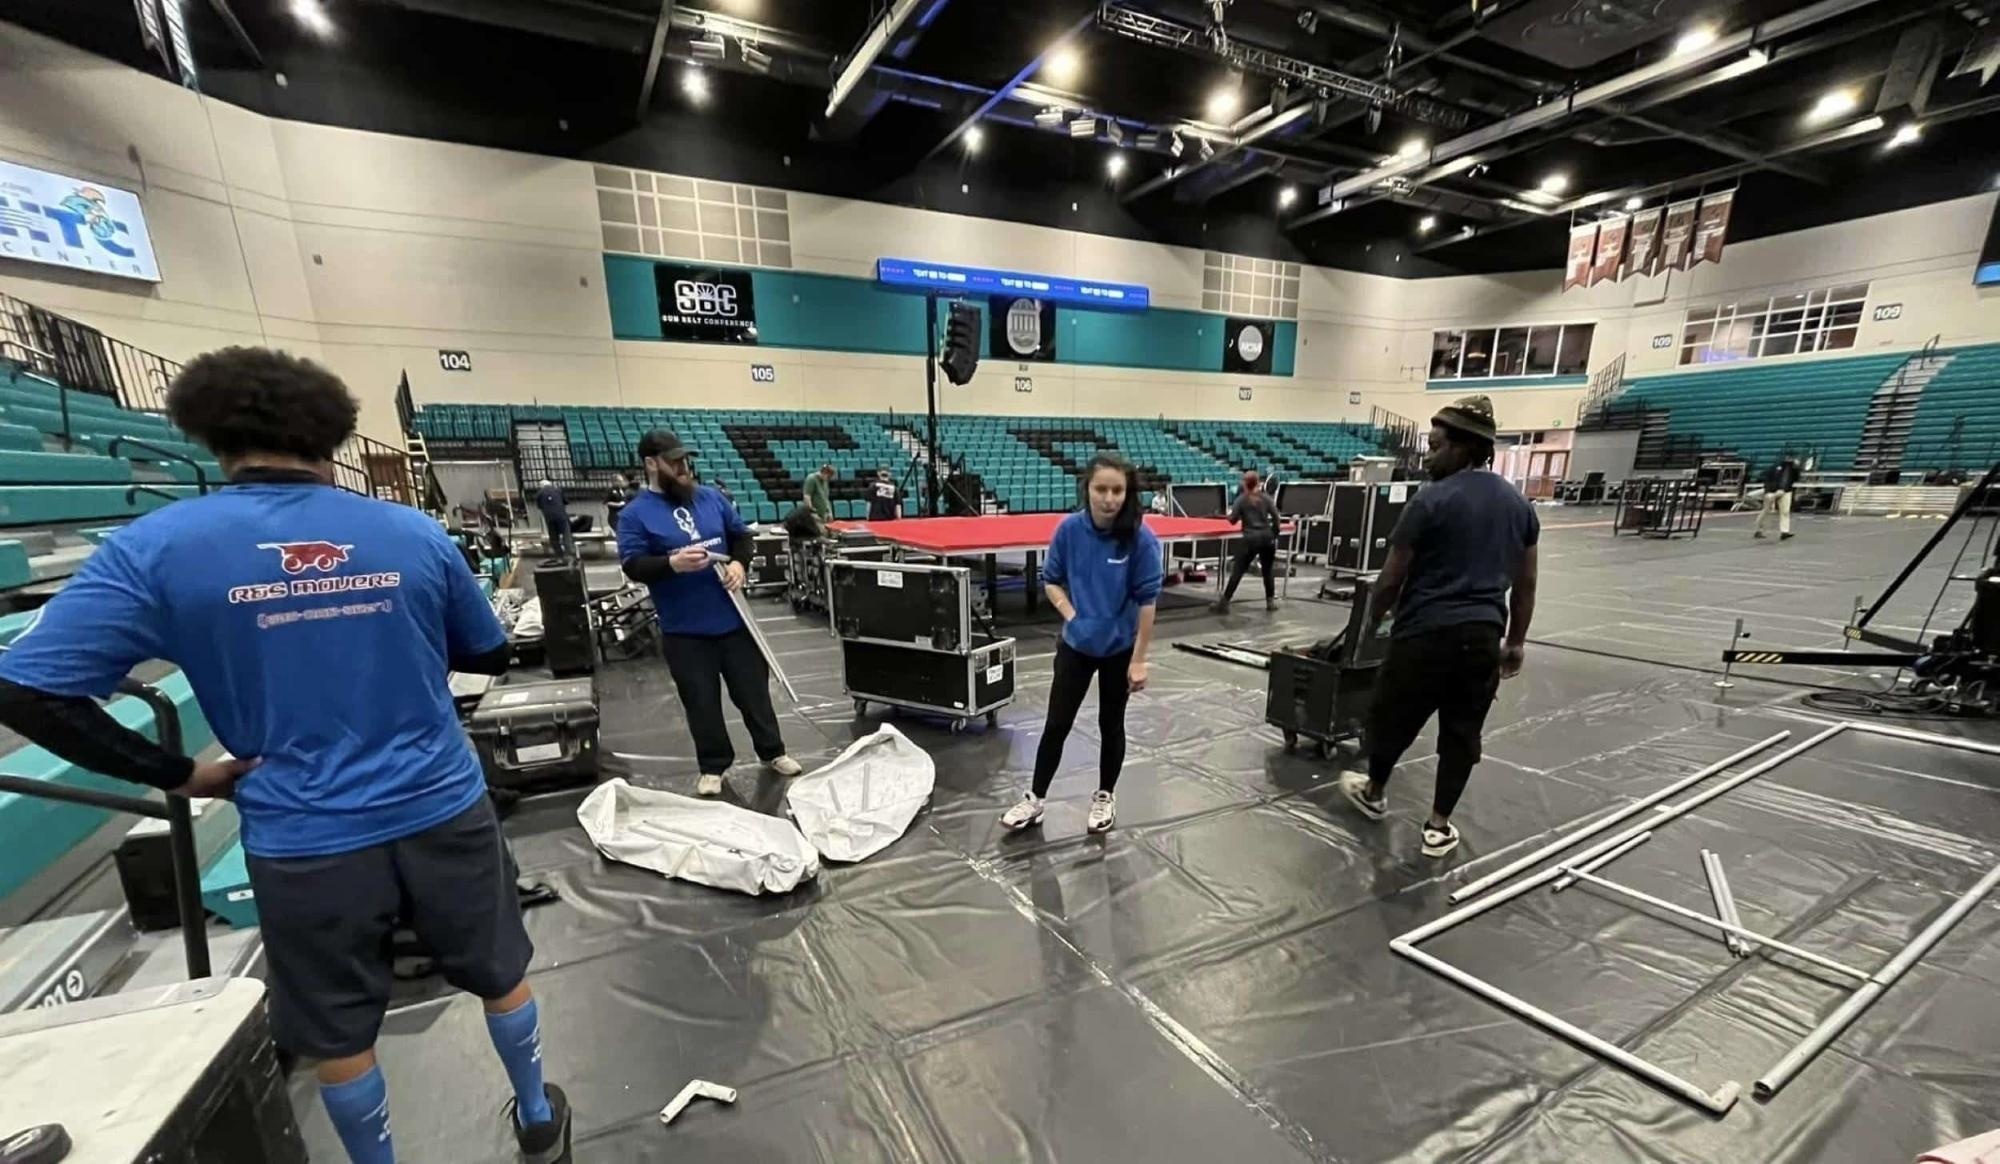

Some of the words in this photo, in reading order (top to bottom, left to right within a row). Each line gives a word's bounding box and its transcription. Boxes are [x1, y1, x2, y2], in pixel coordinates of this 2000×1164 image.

[674, 280, 738, 316] SBC
[1875, 305, 1901, 320] 109
[440, 353, 470, 369] 104
[752, 366, 773, 381] 105
